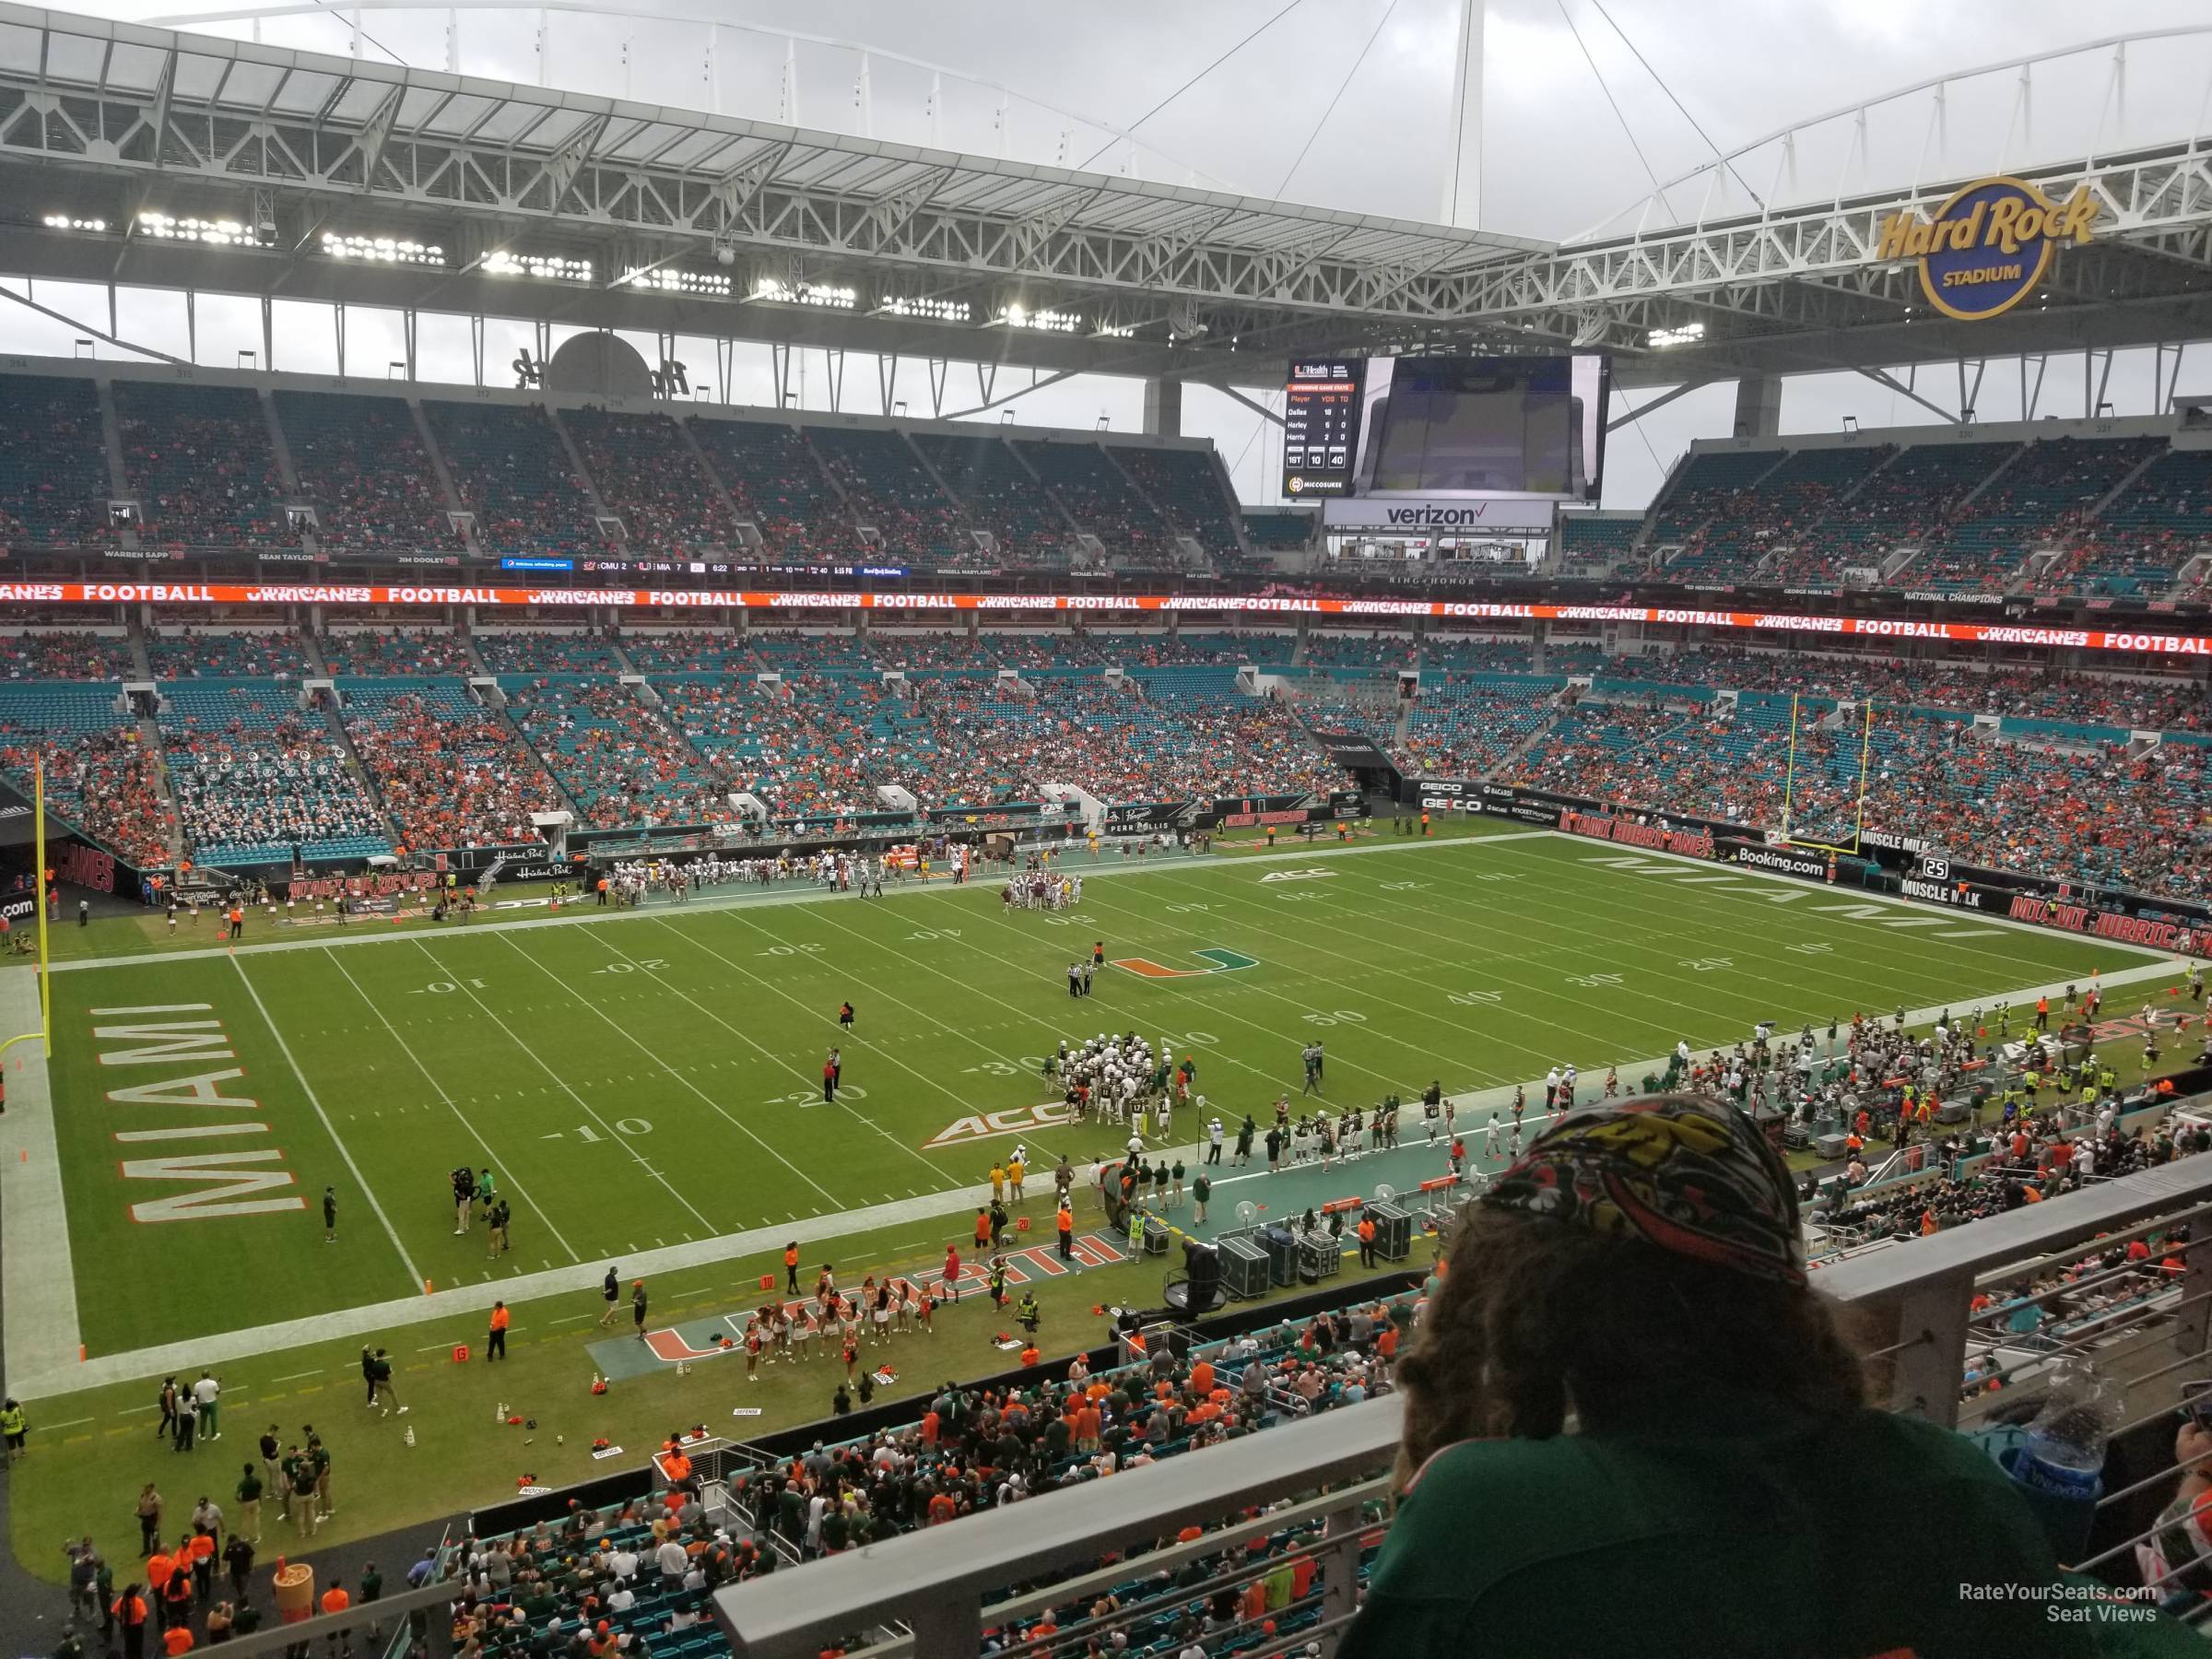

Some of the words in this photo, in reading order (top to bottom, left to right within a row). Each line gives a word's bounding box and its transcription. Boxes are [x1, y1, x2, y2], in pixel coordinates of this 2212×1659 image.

[1877, 200, 1988, 260] Hard
[1984, 185, 2100, 254] Rock
[1943, 265, 2022, 288] STADIUM
[1288, 421, 1307, 429] Harley
[1312, 456, 1321, 465] 10
[1331, 456, 1343, 465] 40
[1387, 504, 1475, 525] verizon
[104, 550, 144, 559] WARREN
[1903, 592, 1946, 603] NATIONAL
[1948, 593, 2003, 605] CHAMPIONS
[84, 585, 214, 601] FOOTBALL
[388, 588, 501, 604] FOOTBALL
[650, 591, 746, 606] FOOTBALL
[873, 594, 956, 608] FOOTBALL
[1066, 596, 1140, 609] FOOTBALL
[1238, 599, 1321, 612] FOOTBALL
[1443, 604, 1534, 618] FOOTBALL
[1656, 609, 1735, 626] FOOTBALL
[1855, 618, 1951, 639] FOOTBALL
[1420, 782, 1463, 792] GEICO
[1422, 797, 1482, 811] GECO
[1512, 806, 1534, 817] ROCKET
[1533, 809, 1556, 820] Mortgage
[1861, 831, 1902, 849] MUSCLE
[1903, 835, 1932, 853] MILK
[494, 850, 526, 860] Hialeah
[527, 849, 544, 858] Park
[1739, 847, 1824, 877] Booking.com
[517, 867, 552, 879] Hialeah
[553, 864, 571, 875] Park
[1259, 868, 1338, 882] ACC
[1927, 860, 1945, 877] 25
[1901, 879, 1948, 902] MUSCLE
[771, 942, 827, 957] 30
[1785, 943, 1834, 955] 10
[606, 958, 671, 975] 20
[1677, 958, 1730, 971] 20
[429, 977, 489, 995] 10
[1565, 972, 1618, 987] 30
[1447, 990, 1502, 1007] 40
[1301, 1009, 1368, 1028] 50
[1159, 1031, 1220, 1051] 40
[785, 1084, 869, 1108] 20
[90, 1003, 309, 1223] MIAMI
[933, 1101, 1067, 1141] ACC
[574, 1118, 653, 1144] 10
[1019, 1218, 1029, 1229] 20
[762, 1277, 773, 1288] 10
[457, 1347, 466, 1360] G
[764, 1479, 773, 1493] 5
